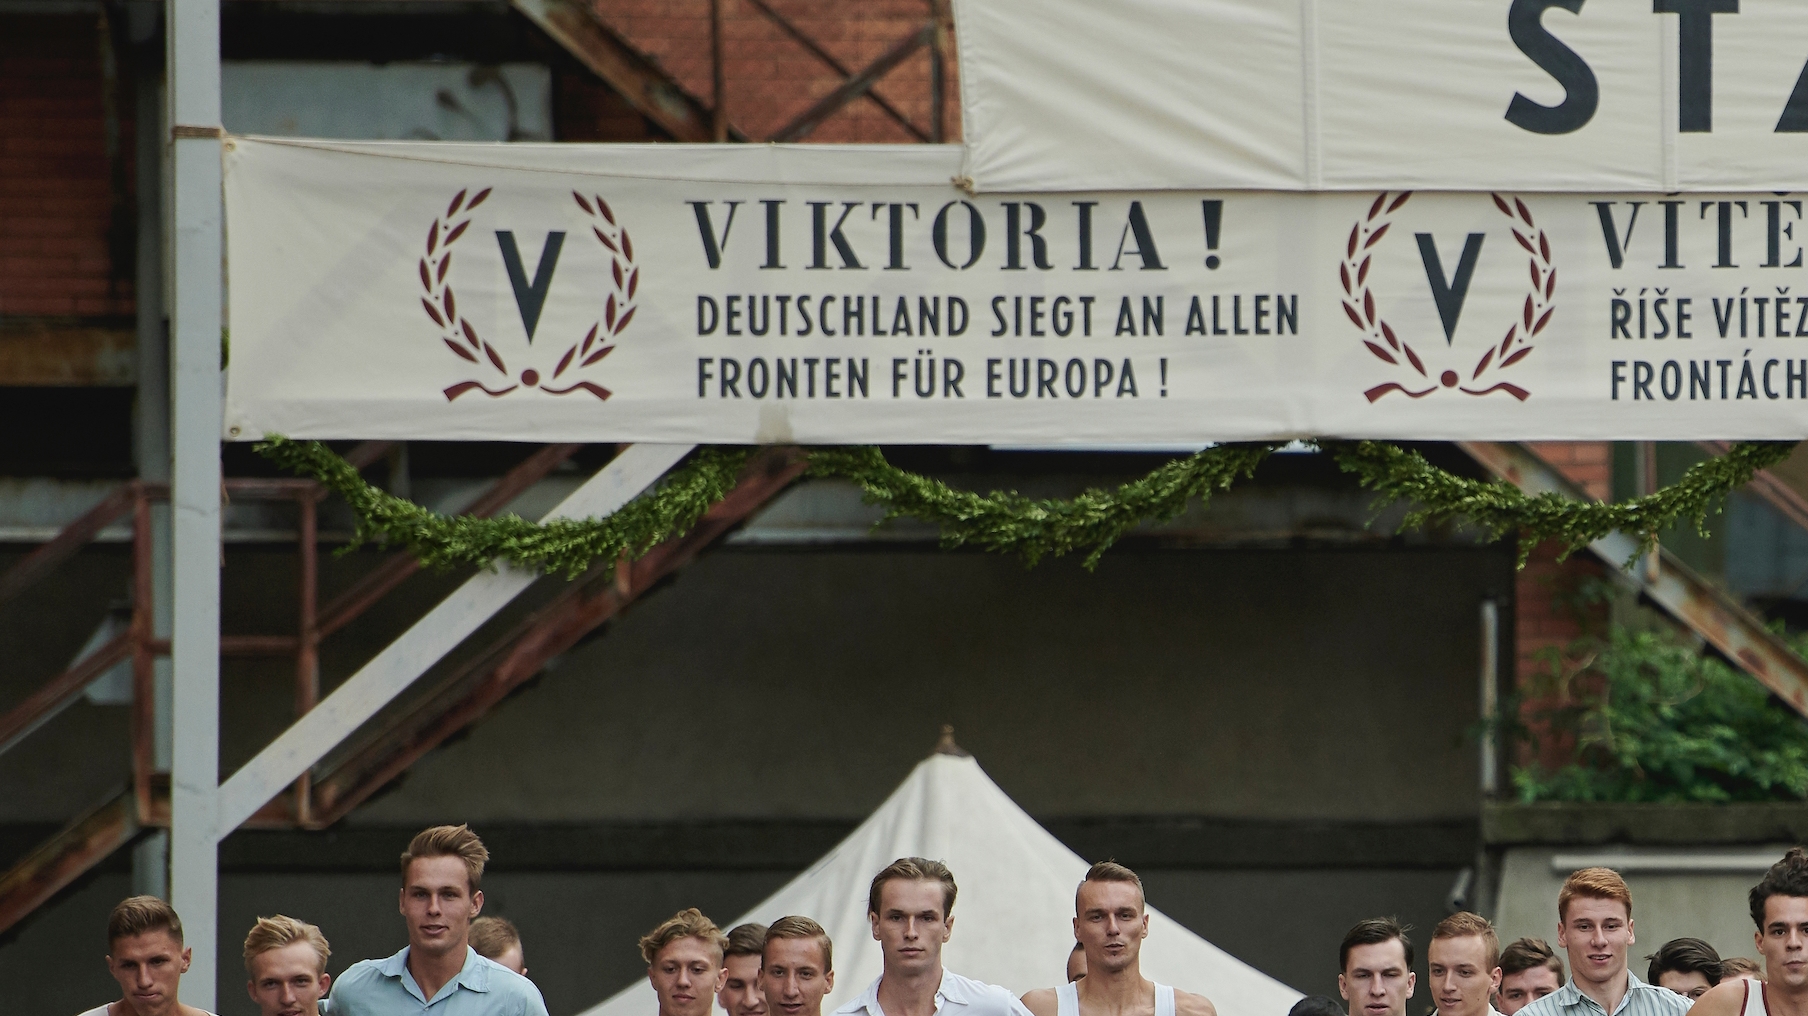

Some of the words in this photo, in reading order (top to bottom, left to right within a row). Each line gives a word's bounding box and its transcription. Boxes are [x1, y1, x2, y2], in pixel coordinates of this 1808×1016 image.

[685, 199, 1168, 271] VIKTORIA
[495, 230, 566, 344] V
[1415, 232, 1485, 346] V
[1611, 287, 1692, 340] ŘÍŠE
[697, 294, 969, 337] DEUTSCHLAND
[991, 295, 1095, 337] SIEGT
[1115, 295, 1164, 337] AN
[1185, 294, 1298, 336] ALLEN
[698, 357, 869, 399] FRONTEN
[892, 349, 965, 398] FÜR
[987, 357, 1138, 398] EUROPA
[1611, 348, 1807, 401] FRONTÁCH
